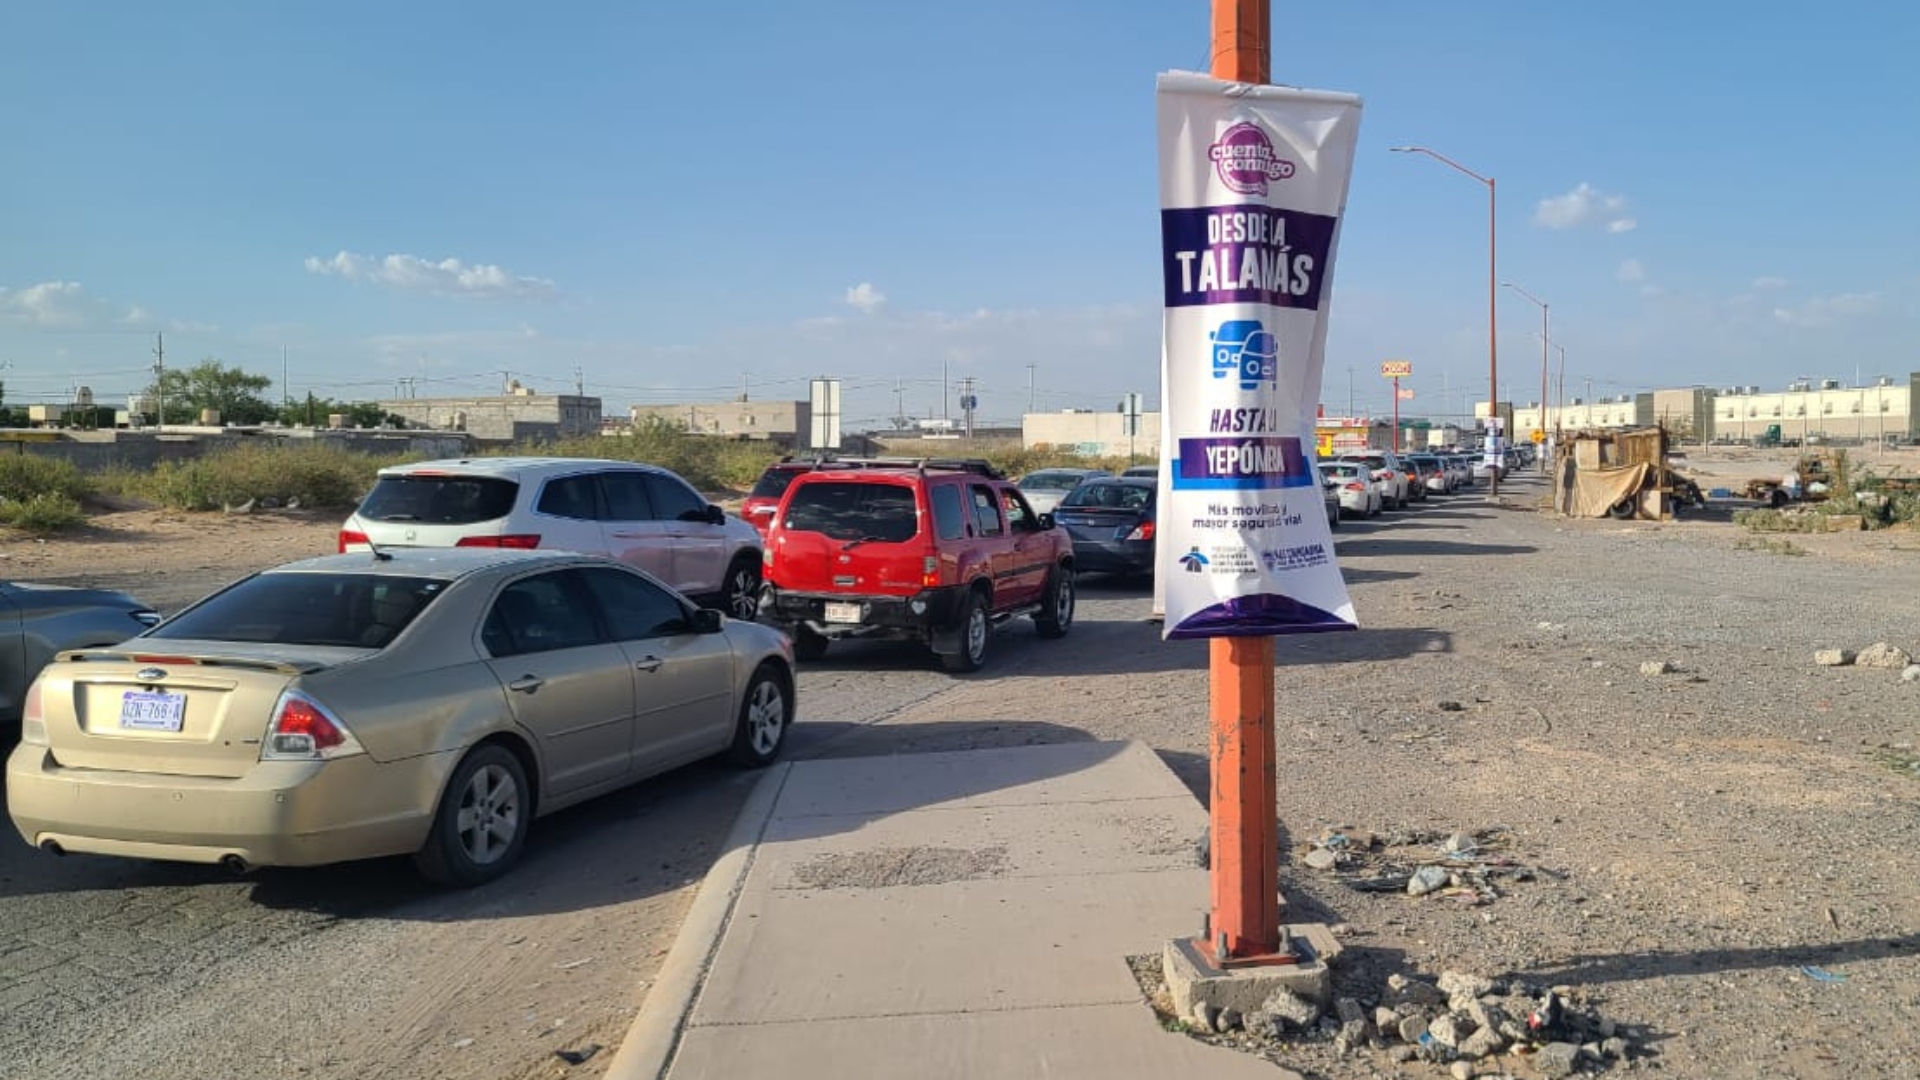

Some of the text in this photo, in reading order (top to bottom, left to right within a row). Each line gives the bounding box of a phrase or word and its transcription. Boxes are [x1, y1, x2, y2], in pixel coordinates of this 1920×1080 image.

[1211, 144, 1273, 160] cuenta
[1207, 213, 1268, 245] DESDE
[1210, 408, 1267, 433] HASTA
